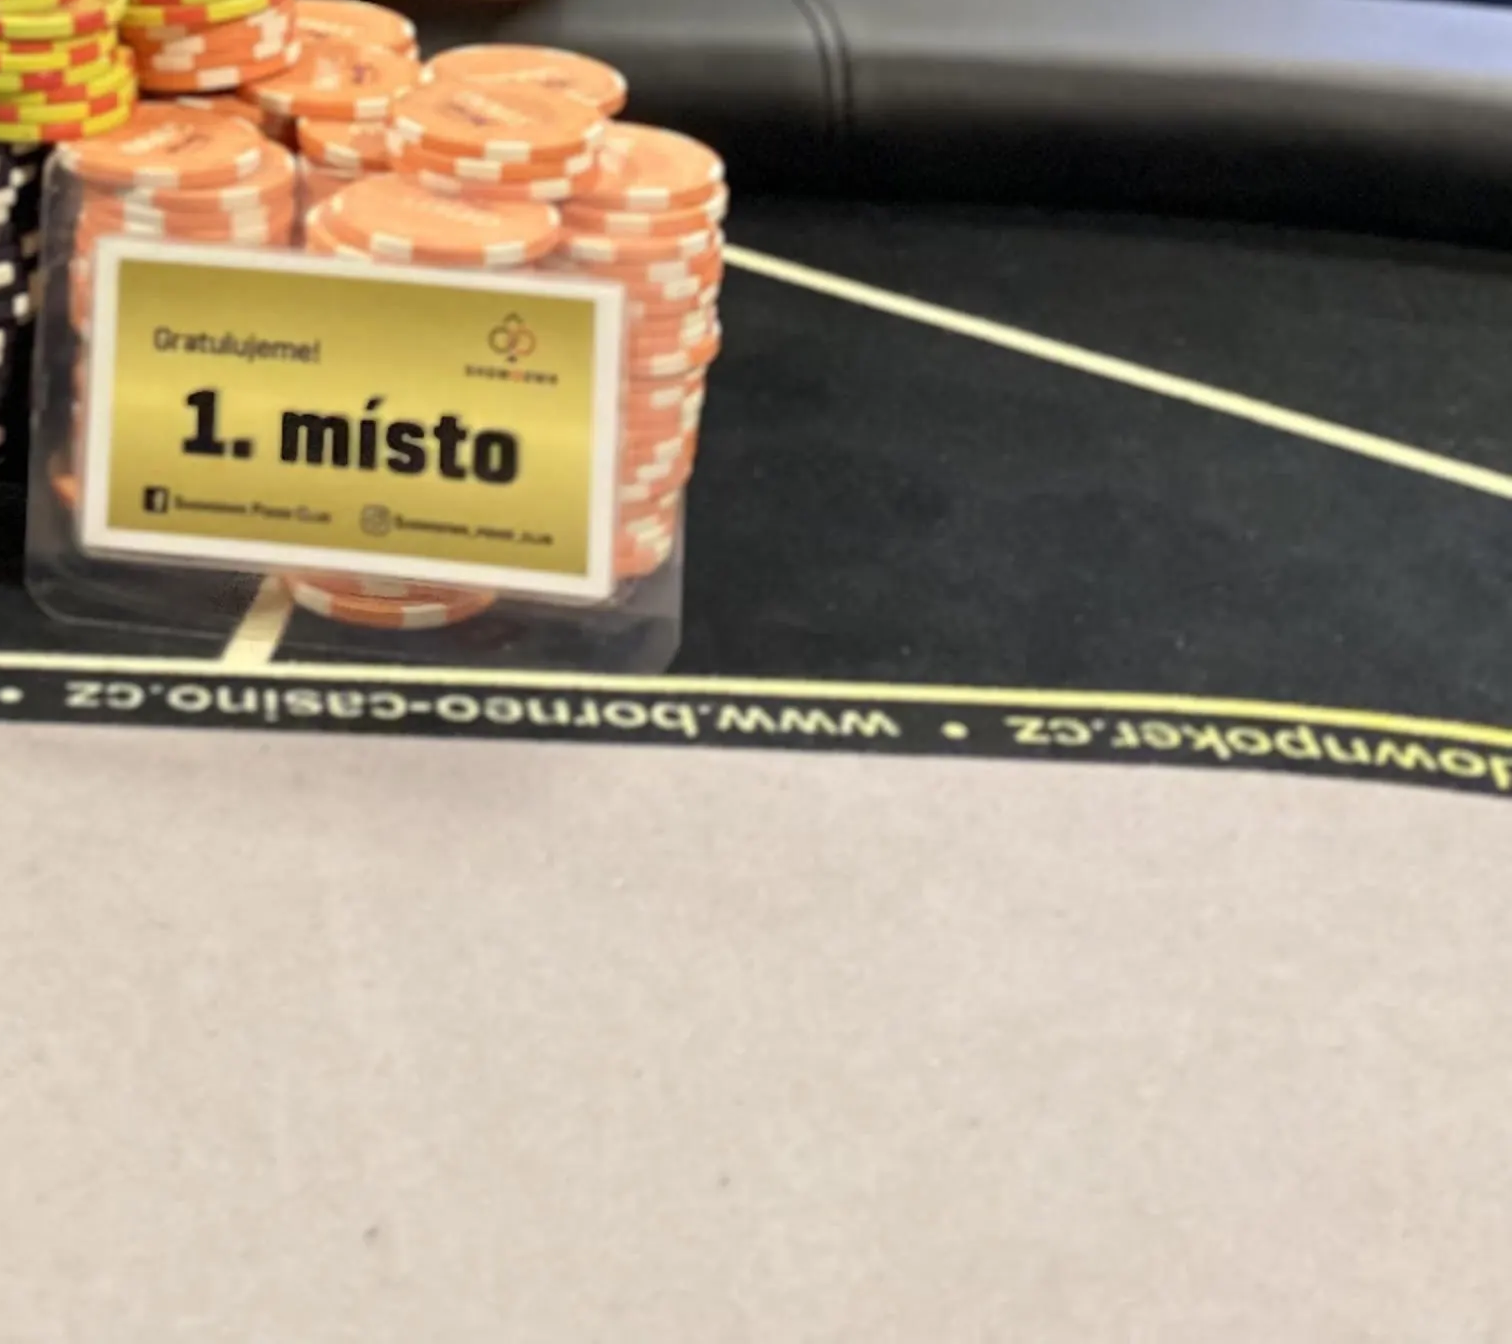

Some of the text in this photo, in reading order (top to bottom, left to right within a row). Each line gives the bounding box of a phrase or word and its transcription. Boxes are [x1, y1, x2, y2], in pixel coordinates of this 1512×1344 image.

[153, 325, 321, 363] Gratulujeme!
[182, 388, 519, 485] 1. místo
[64, 679, 900, 736] www.borneo-casino.cz
